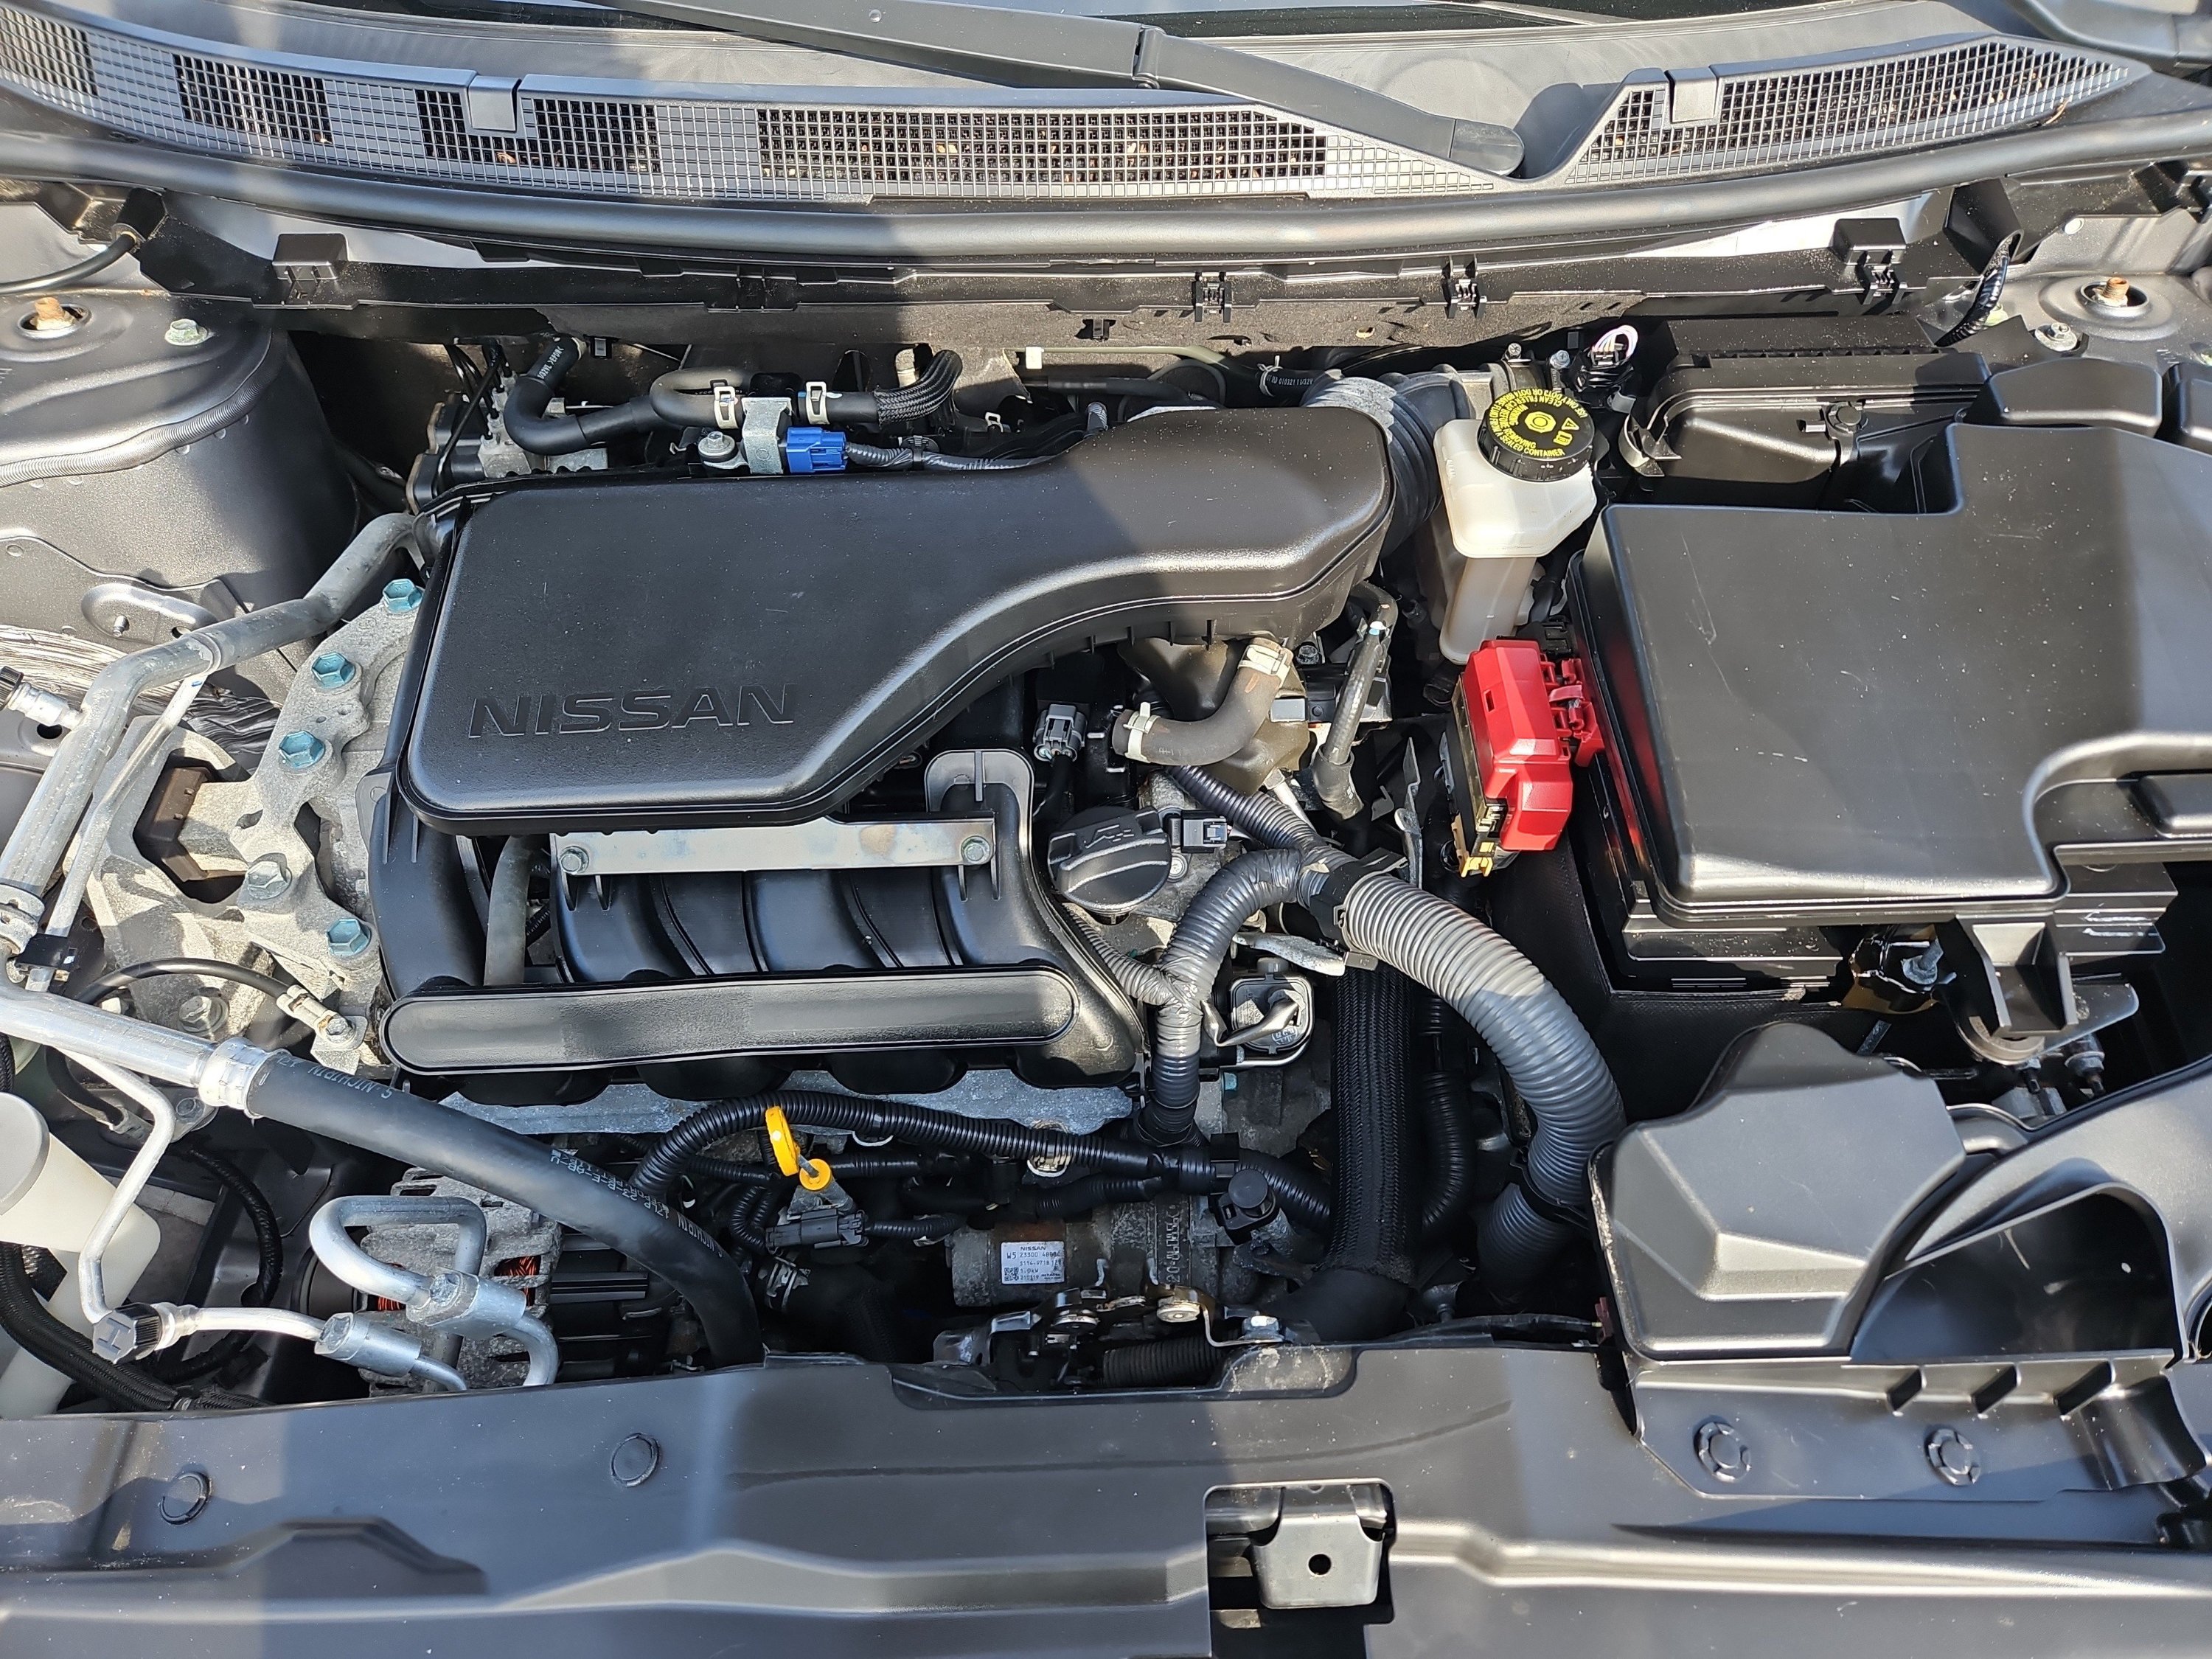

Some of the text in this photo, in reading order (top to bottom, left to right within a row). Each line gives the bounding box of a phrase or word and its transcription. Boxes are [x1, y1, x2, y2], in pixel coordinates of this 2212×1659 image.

[1495, 392, 1516, 407] BRAKE
[1513, 389, 1532, 398] DOT4
[1543, 389, 1563, 400] DOT3
[1561, 396, 1579, 409] ONLY
[1509, 403, 1529, 426] WARNING
[1574, 407, 1588, 418] USE
[1498, 395, 1562, 449] CLEAN FILLER CAP BEFORE REMOVING
[1499, 435, 1524, 452] SEALED
[1523, 447, 1566, 457] CONTAINER
[468, 683, 799, 738] NISSAN
[96, 1317, 132, 1356] H
